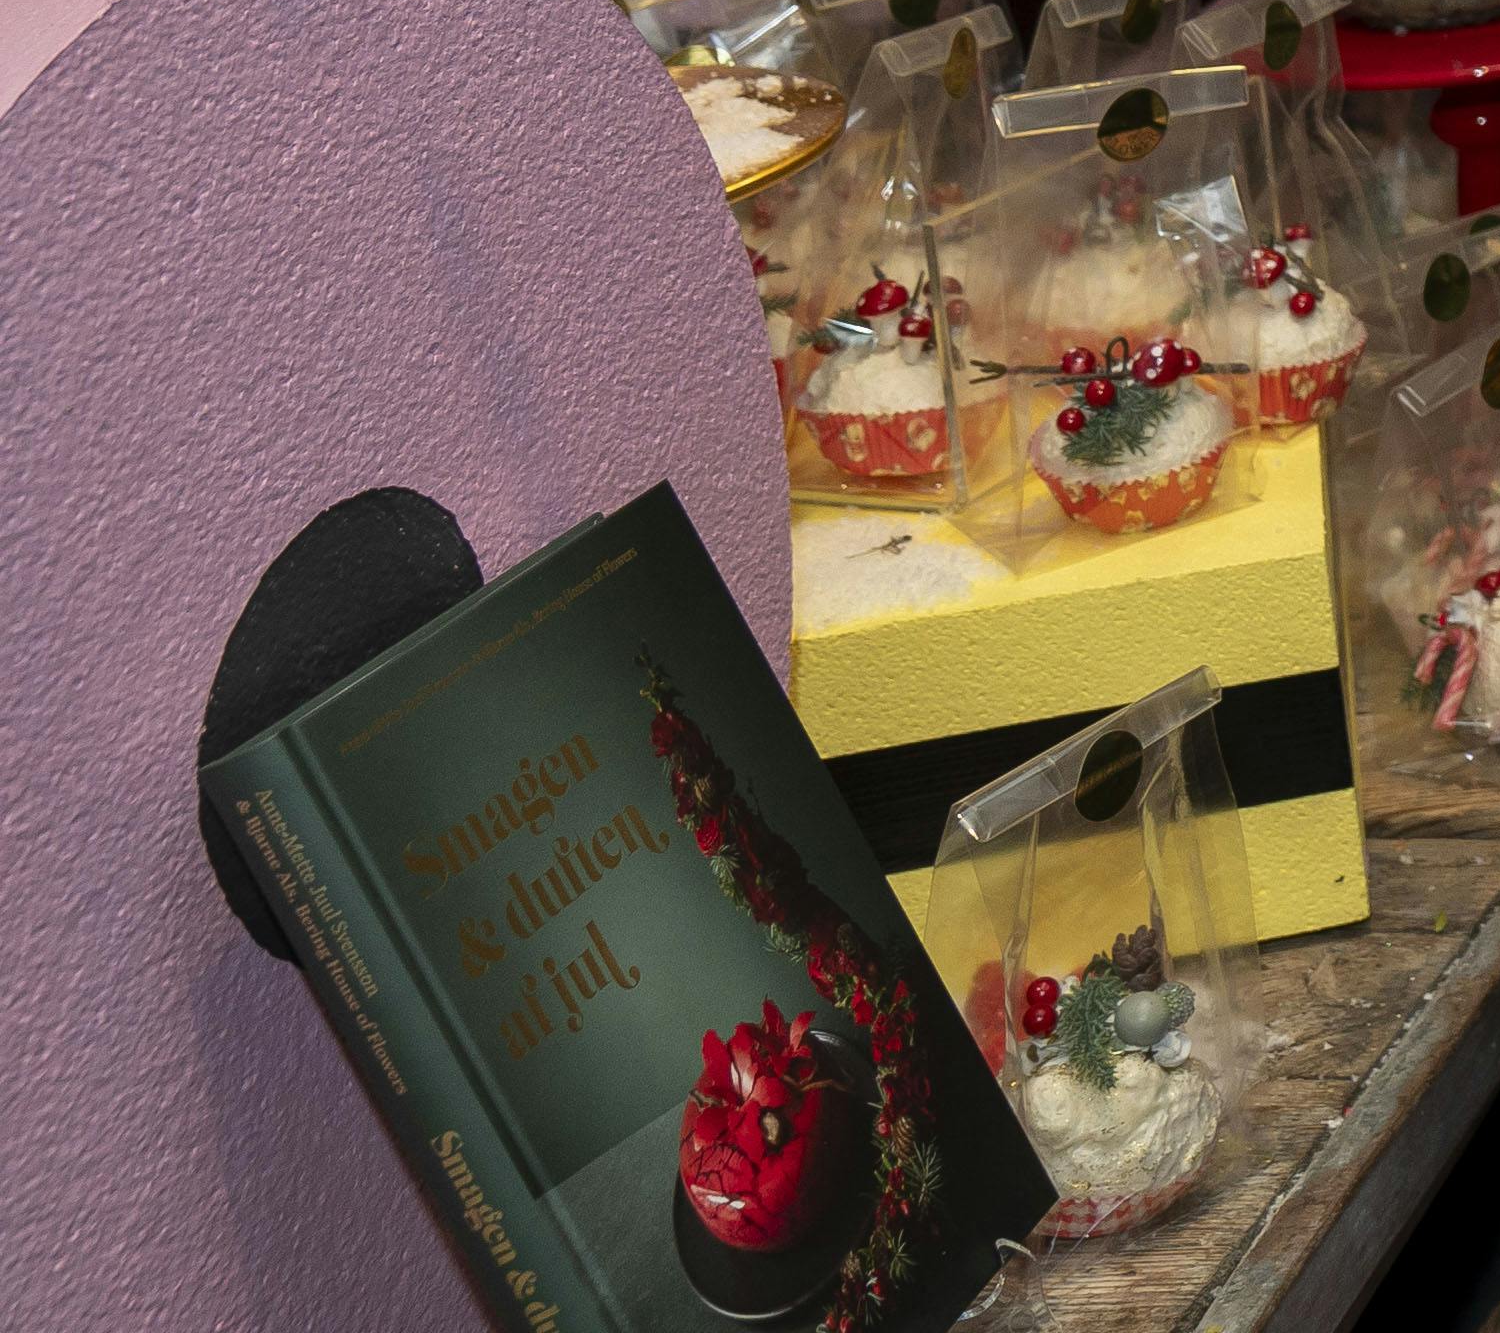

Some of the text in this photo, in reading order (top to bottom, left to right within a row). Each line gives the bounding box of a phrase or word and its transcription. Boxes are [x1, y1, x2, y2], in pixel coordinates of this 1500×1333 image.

[402, 733, 600, 900] Smagen
[458, 804, 670, 979] & duften
[295, 903, 331, 962] Bering
[326, 960, 362, 1013] House
[356, 1011, 378, 1031] of
[367, 1031, 408, 1096] Flowers
[500, 919, 641, 1061] af jul
[431, 1130, 517, 1267] Smagen
[506, 1269, 537, 1300] &
